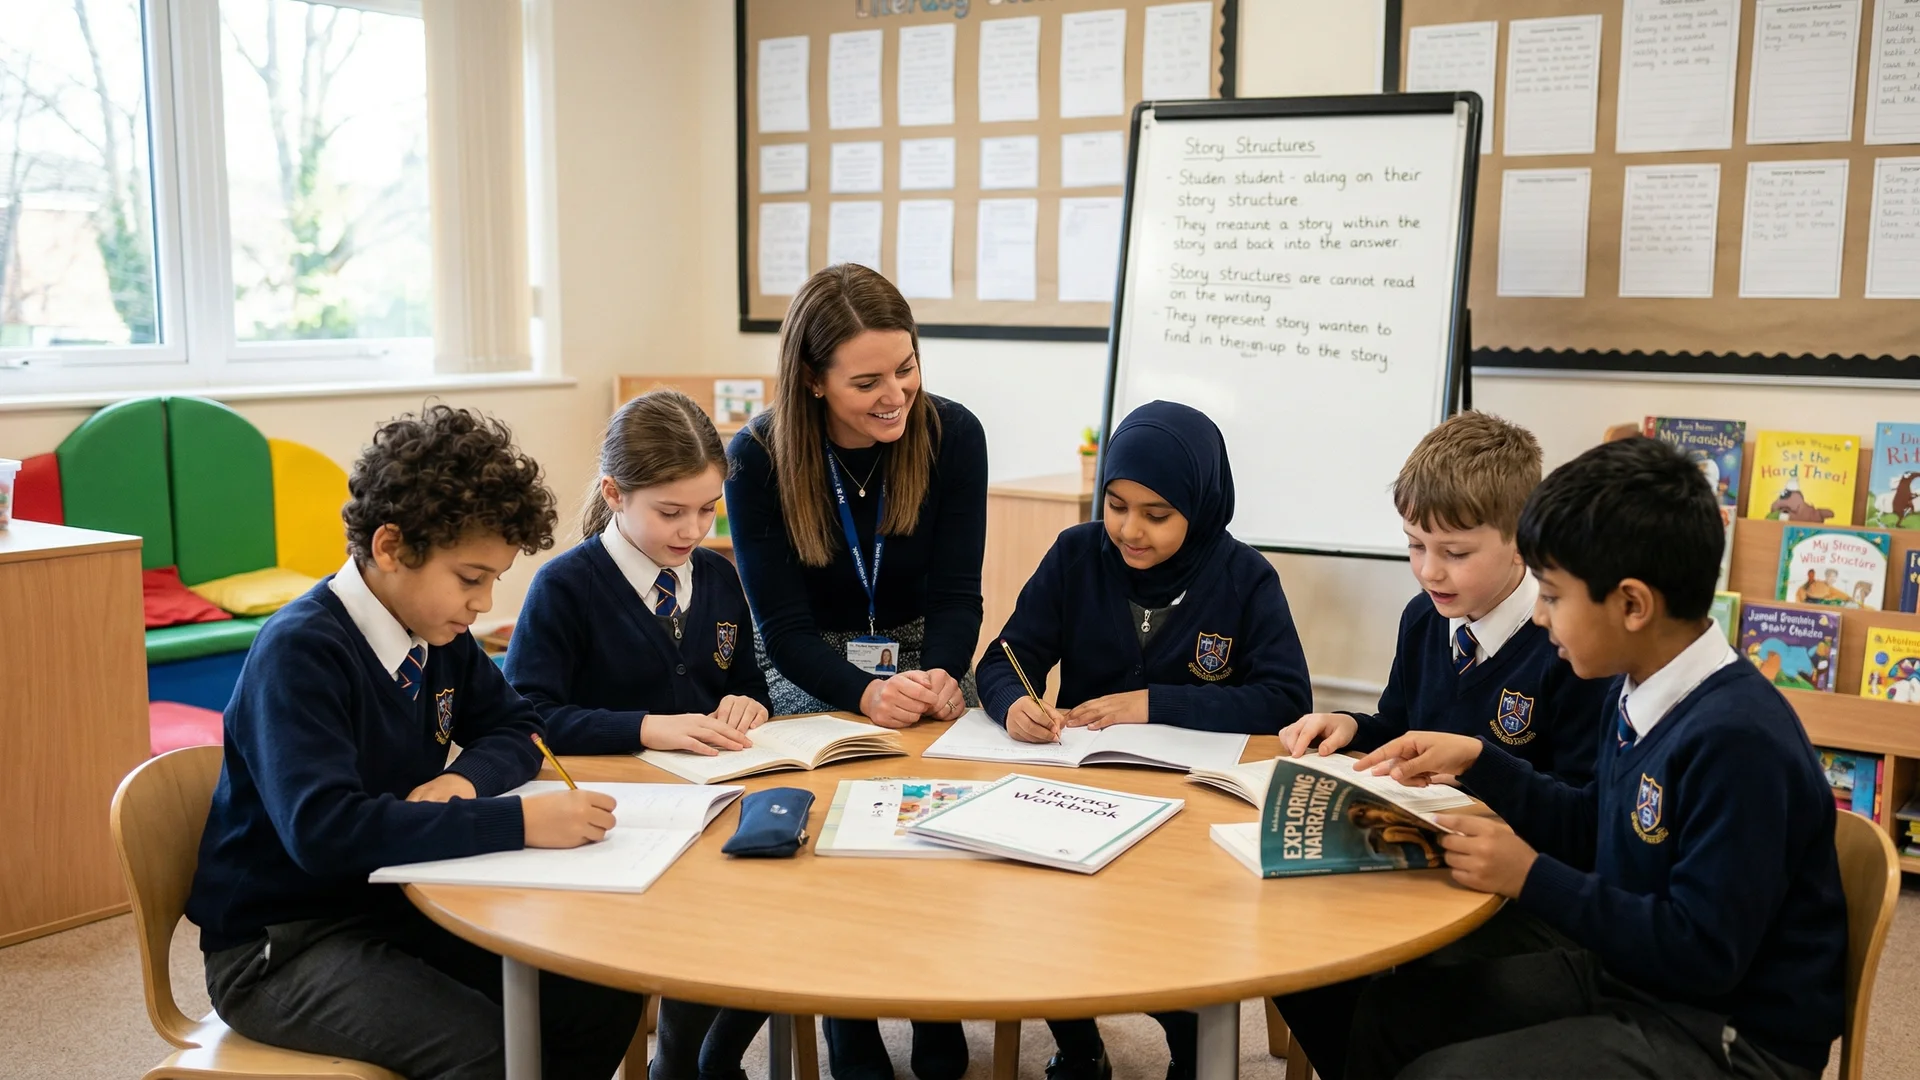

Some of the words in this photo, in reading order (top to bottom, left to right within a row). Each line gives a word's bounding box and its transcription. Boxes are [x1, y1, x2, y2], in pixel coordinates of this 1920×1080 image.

[1186, 137, 1224, 161] Story
[1236, 136, 1315, 153] Structures
[1179, 169, 1225, 185] Studen
[1235, 171, 1284, 184] student
[1356, 172, 1373, 183] on
[1384, 166, 1421, 182] their
[1178, 192, 1215, 213] story
[1174, 215, 1206, 236] They
[1280, 221, 1289, 230] a
[1299, 216, 1333, 235] story
[1343, 216, 1389, 229] within
[1398, 214, 1421, 228] the
[1174, 237, 1205, 256] story
[1214, 238, 1237, 249] and
[1247, 238, 1274, 249] back
[1285, 238, 1310, 249] into
[1320, 235, 1341, 249] the
[1170, 263, 1209, 286] Story
[1219, 267, 1291, 283] structures
[1300, 274, 1321, 285] are
[1330, 275, 1374, 287] cannot
[1383, 274, 1415, 288] read
[1170, 290, 1186, 299] on
[1196, 288, 1216, 300] the
[1225, 292, 1271, 311] writing
[1164, 306, 1196, 328] They
[1206, 314, 1265, 329] represent
[1276, 316, 1309, 336] story
[1377, 321, 1392, 336] to
[1164, 329, 1190, 343] find
[1200, 332, 1212, 344] in
[1296, 342, 1310, 355] to
[1319, 343, 1340, 359] the
[1810, 451, 1830, 464] the
[1761, 464, 1798, 479] Hard
[1813, 540, 1828, 553] My
[1014, 792, 1120, 819] Workbook
[1036, 788, 1120, 809] Literacy
[1283, 773, 1316, 860] EXPLORING
[1304, 776, 1339, 860] NARRATIVES
